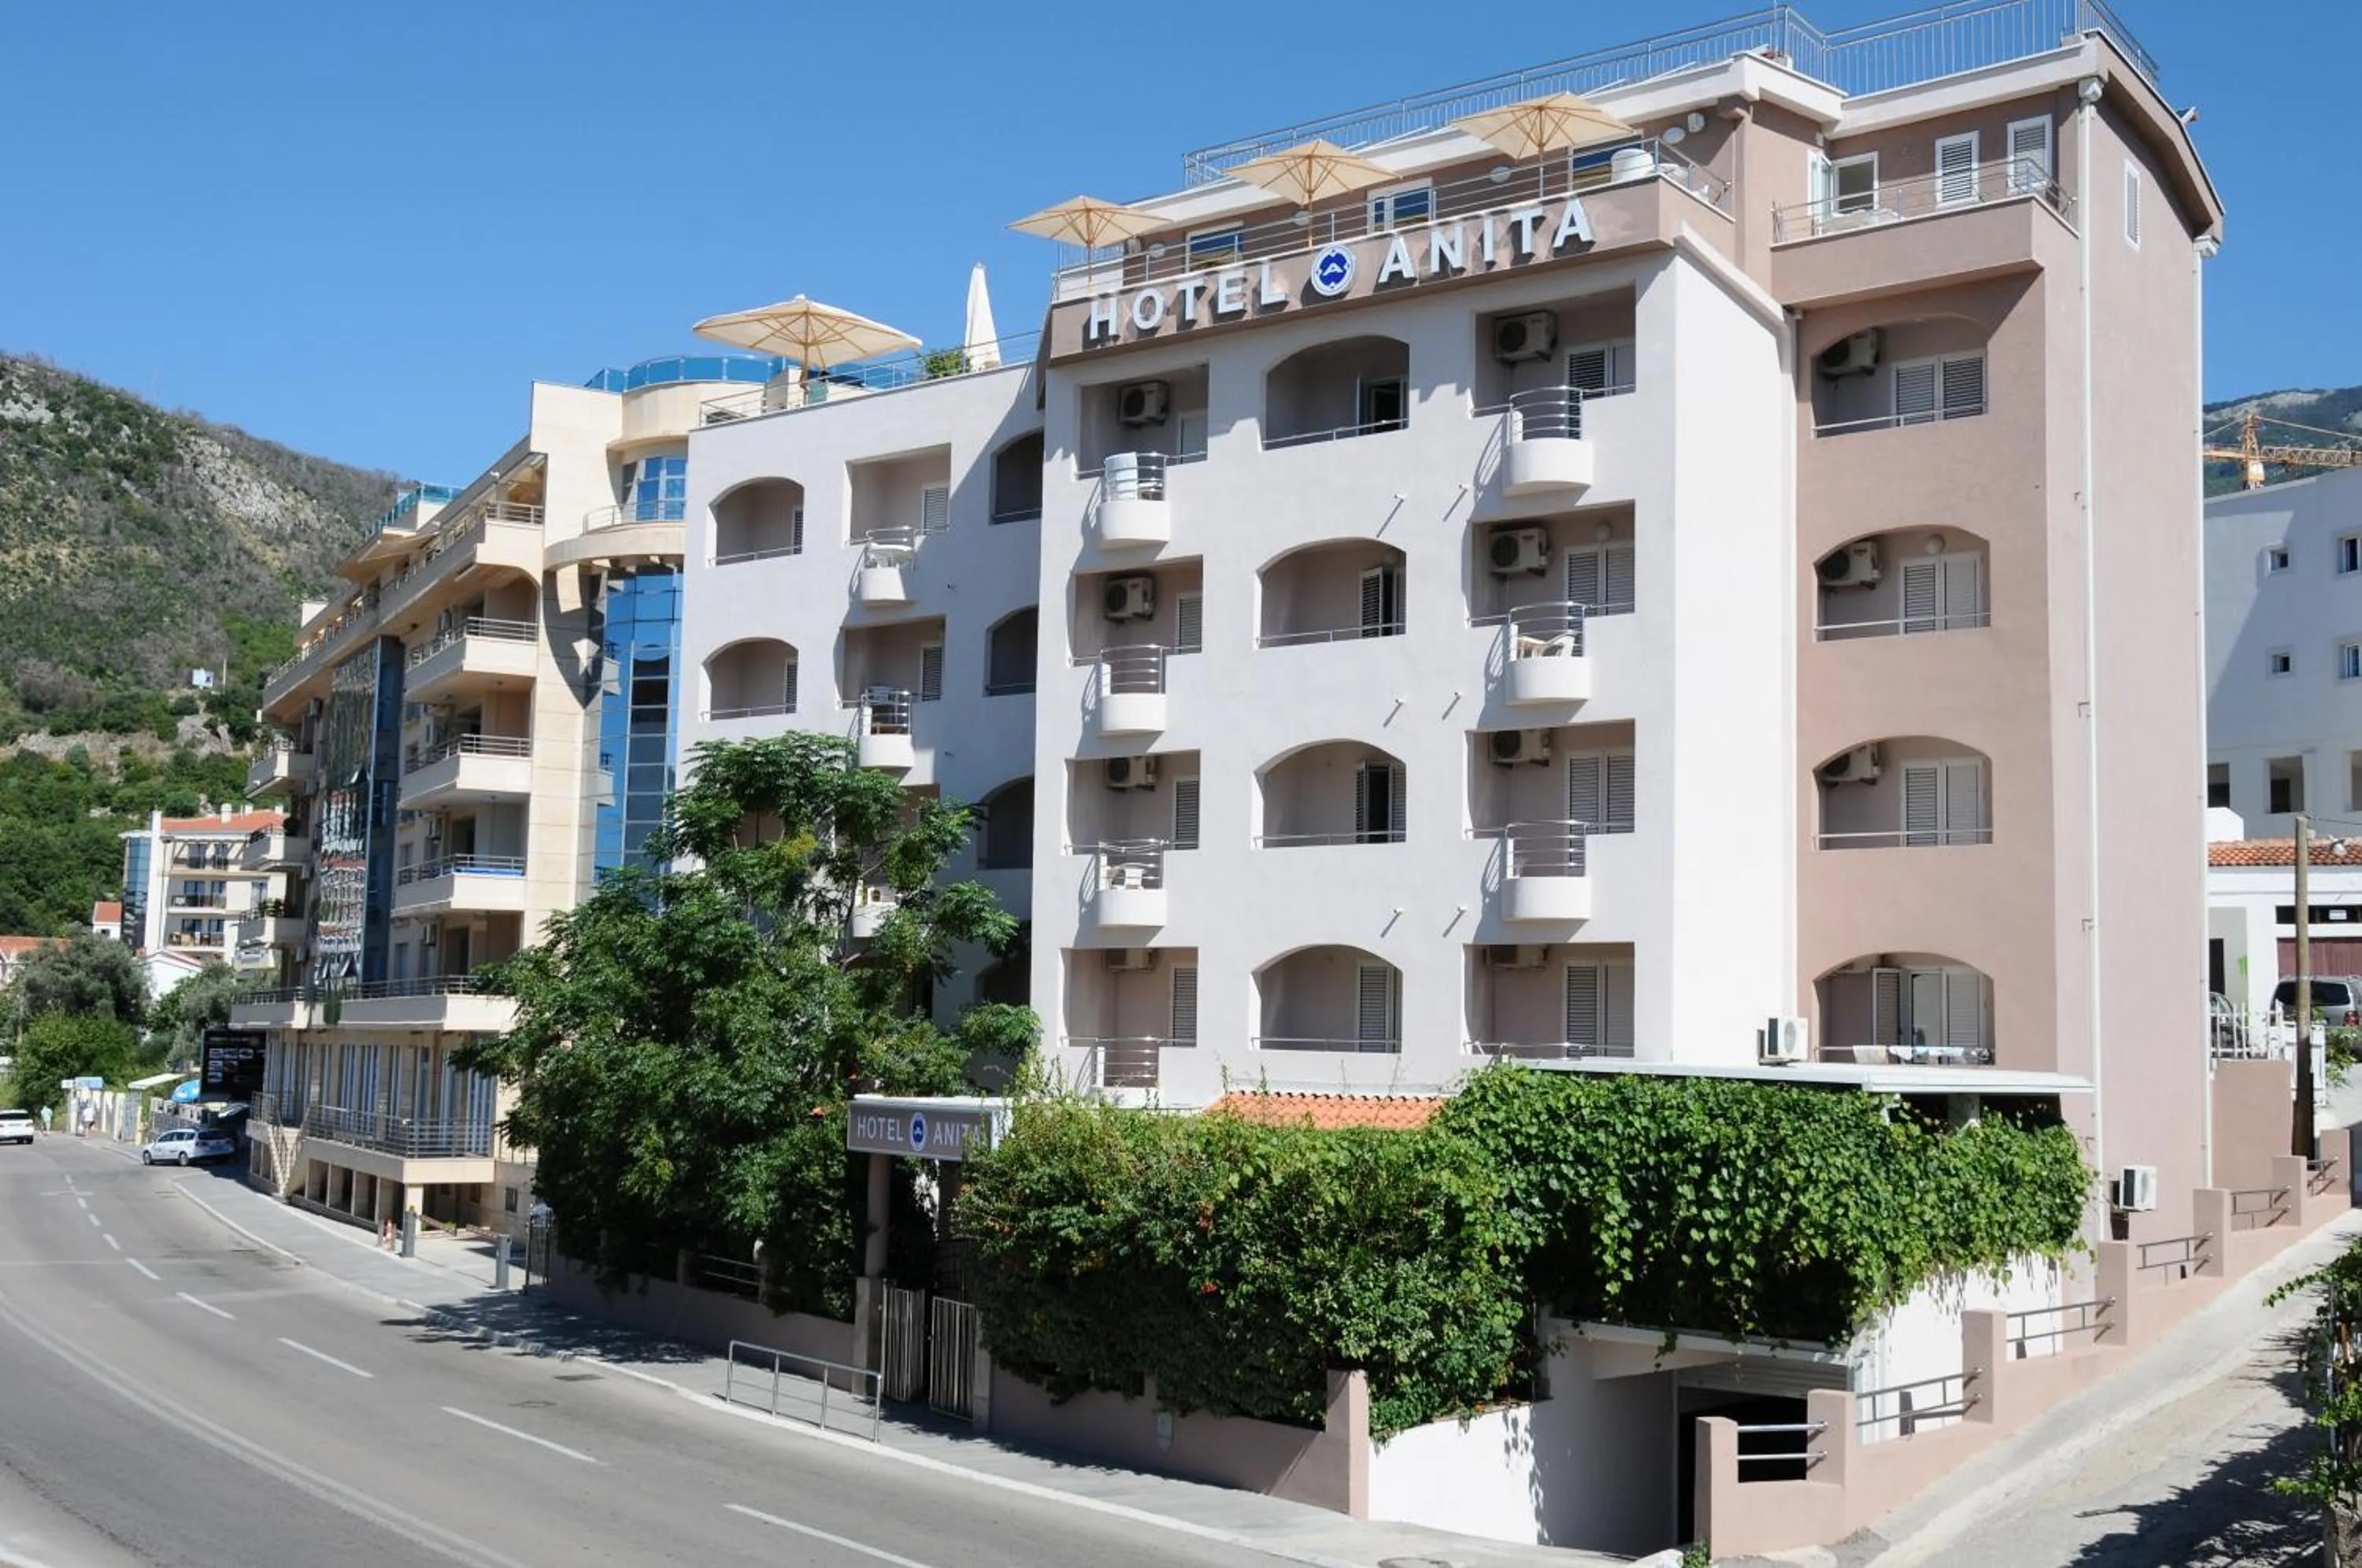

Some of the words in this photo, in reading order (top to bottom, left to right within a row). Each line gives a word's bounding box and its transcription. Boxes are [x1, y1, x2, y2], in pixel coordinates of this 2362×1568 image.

[1089, 262, 1288, 340] HOTEL
[1378, 197, 1594, 283] ANITA
[857, 1115, 903, 1141] HOTEL
